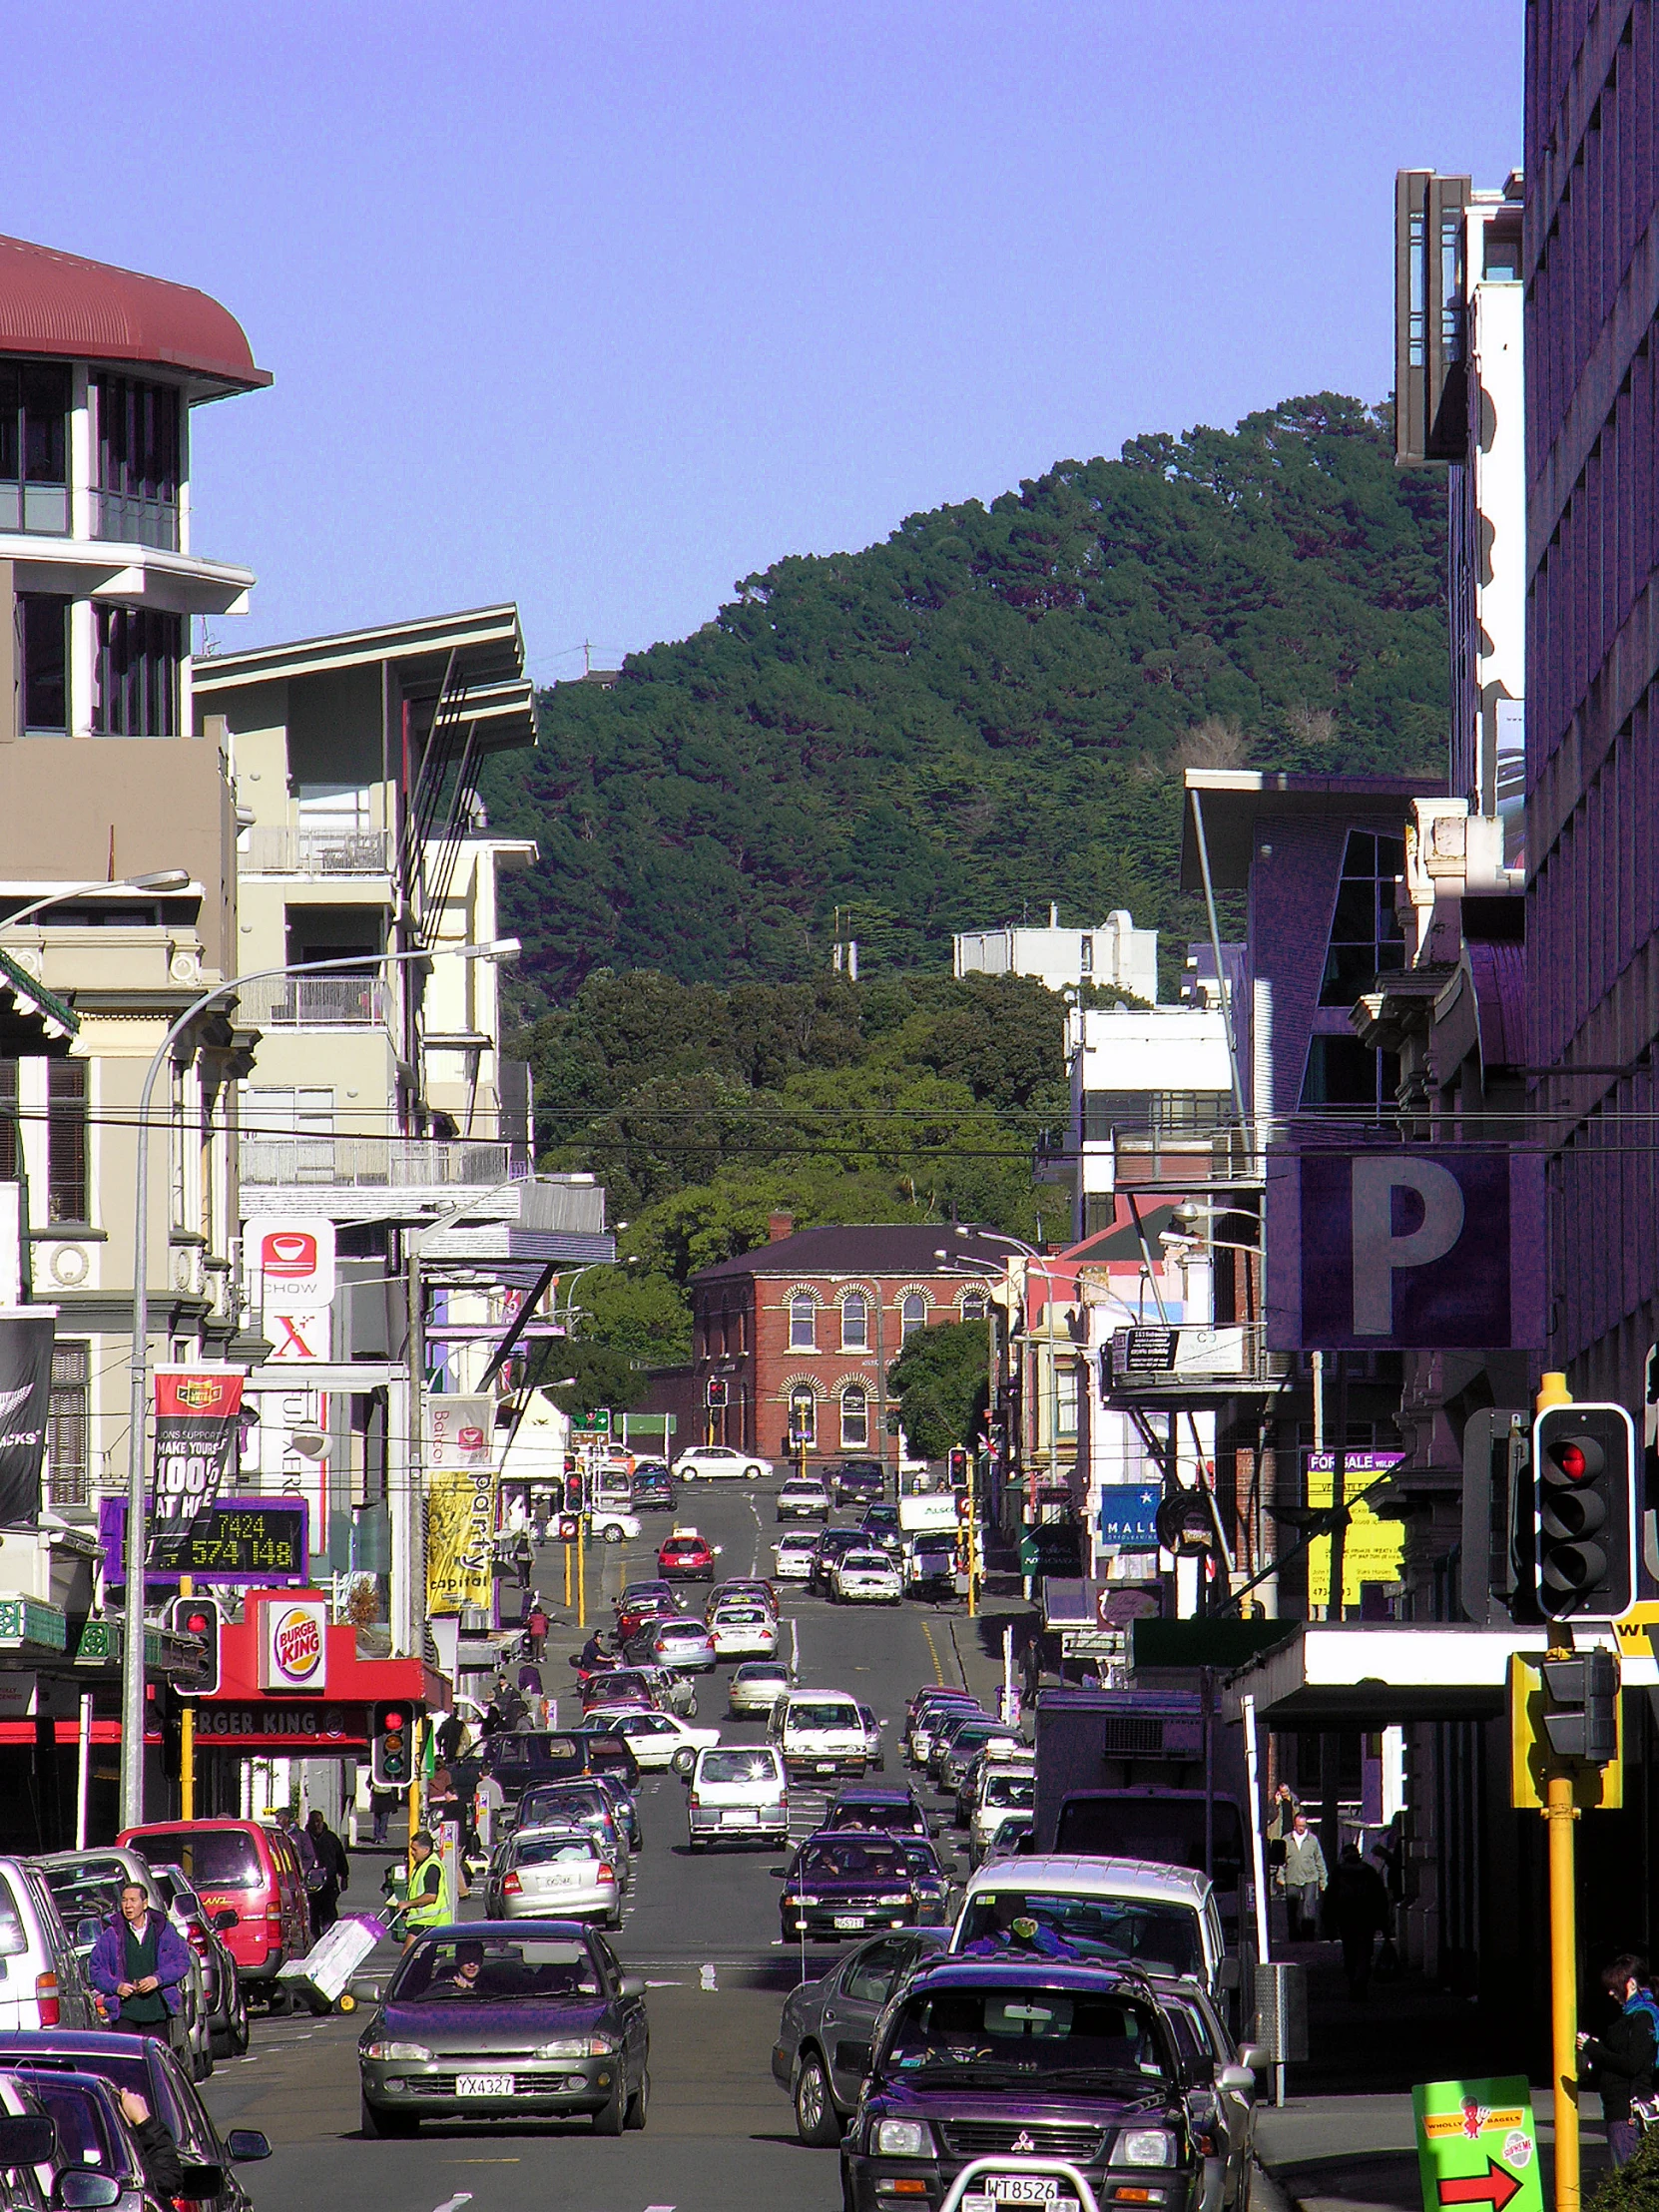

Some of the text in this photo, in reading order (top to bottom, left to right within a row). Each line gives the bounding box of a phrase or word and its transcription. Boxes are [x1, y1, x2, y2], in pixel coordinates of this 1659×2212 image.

[1351, 1154, 1465, 1336] P
[262, 1283, 318, 1295] CHOW
[157, 1441, 188, 1455] MAKE
[1310, 1455, 1336, 1469] FOR
[156, 1486, 216, 1518] AT HOE
[219, 1514, 266, 1538] 7424
[460, 1472, 492, 1571] party
[430, 1575, 487, 1591] capital
[278, 1619, 317, 1648] BURGER
[280, 1632, 319, 1666] KING
[200, 1711, 317, 1735] RGER KING
[458, 2078, 512, 2094] YX4327
[1427, 2115, 1522, 2130] WHOLLY BAGELS
[1503, 2139, 1533, 2158] SUPREME
[986, 2179, 1056, 2200] WT8526
